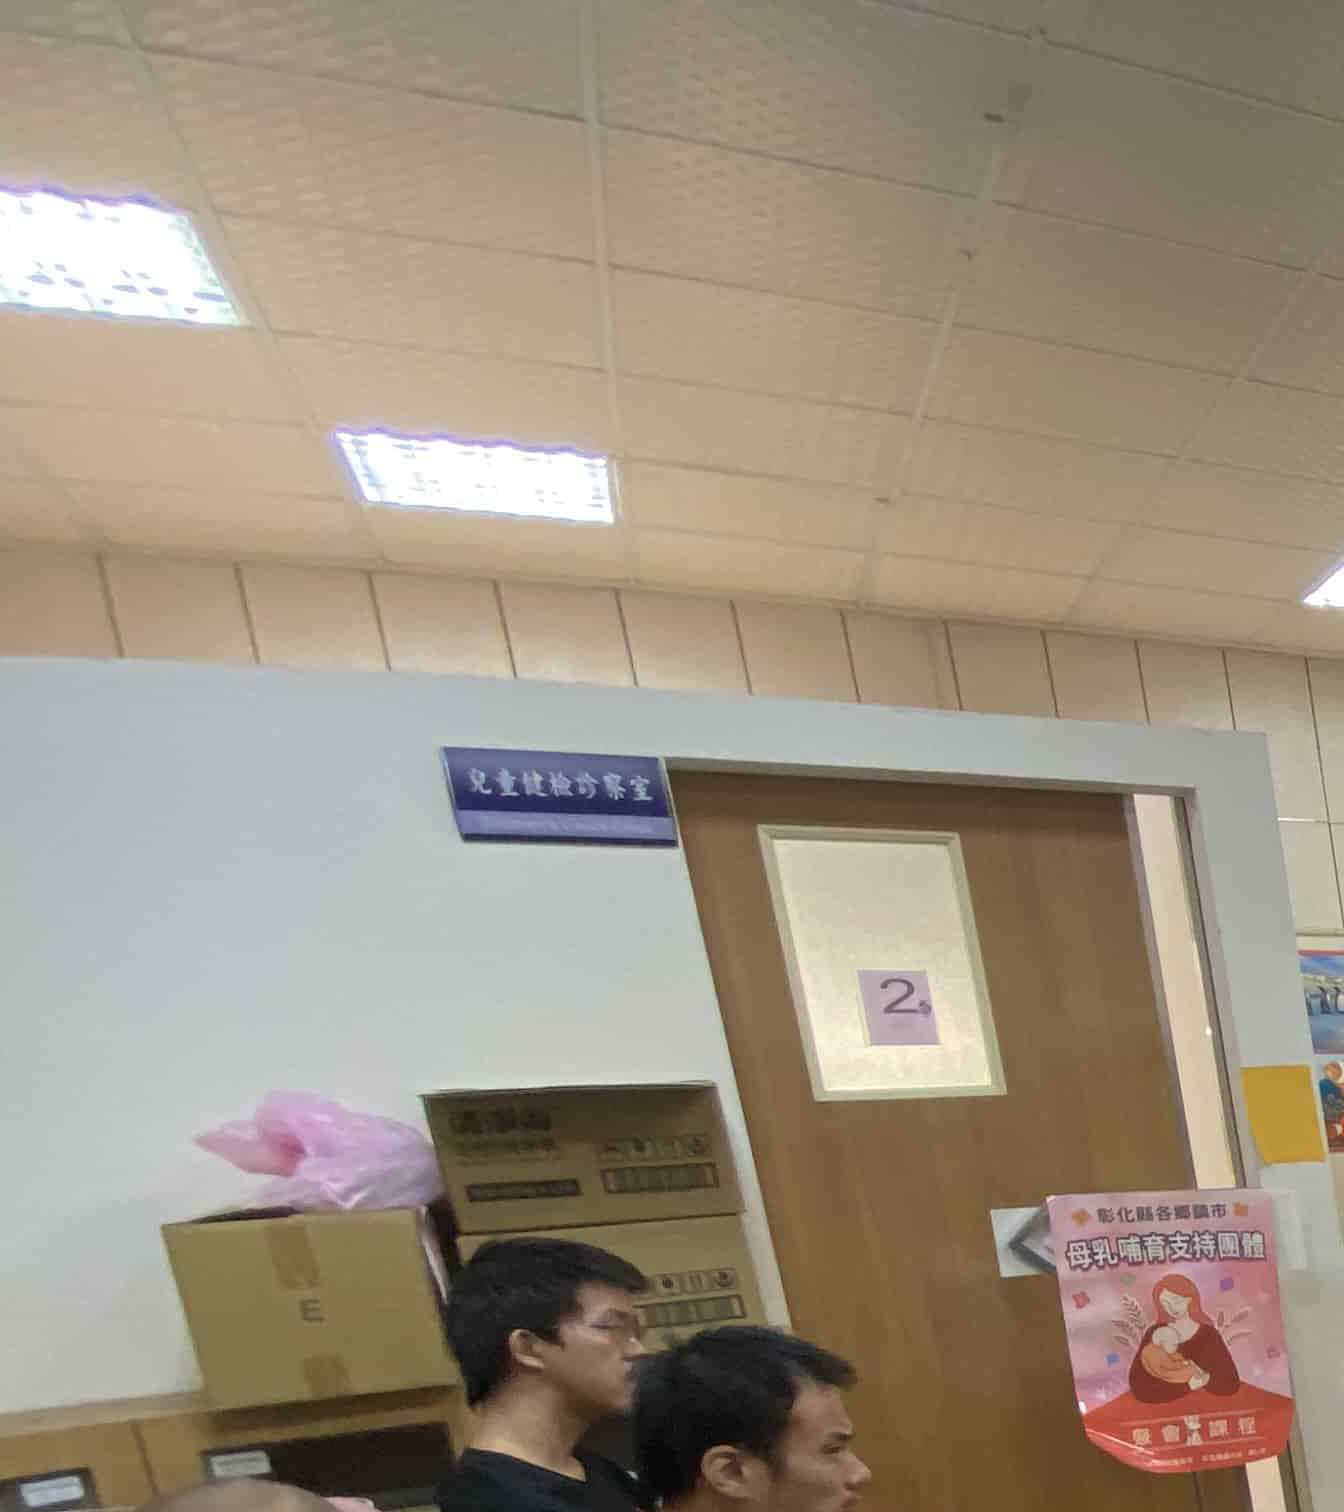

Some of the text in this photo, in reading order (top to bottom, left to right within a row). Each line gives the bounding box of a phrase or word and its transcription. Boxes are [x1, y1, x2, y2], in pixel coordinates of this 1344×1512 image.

[1066, 1231, 1266, 1271] 母乳哺育支持團體
